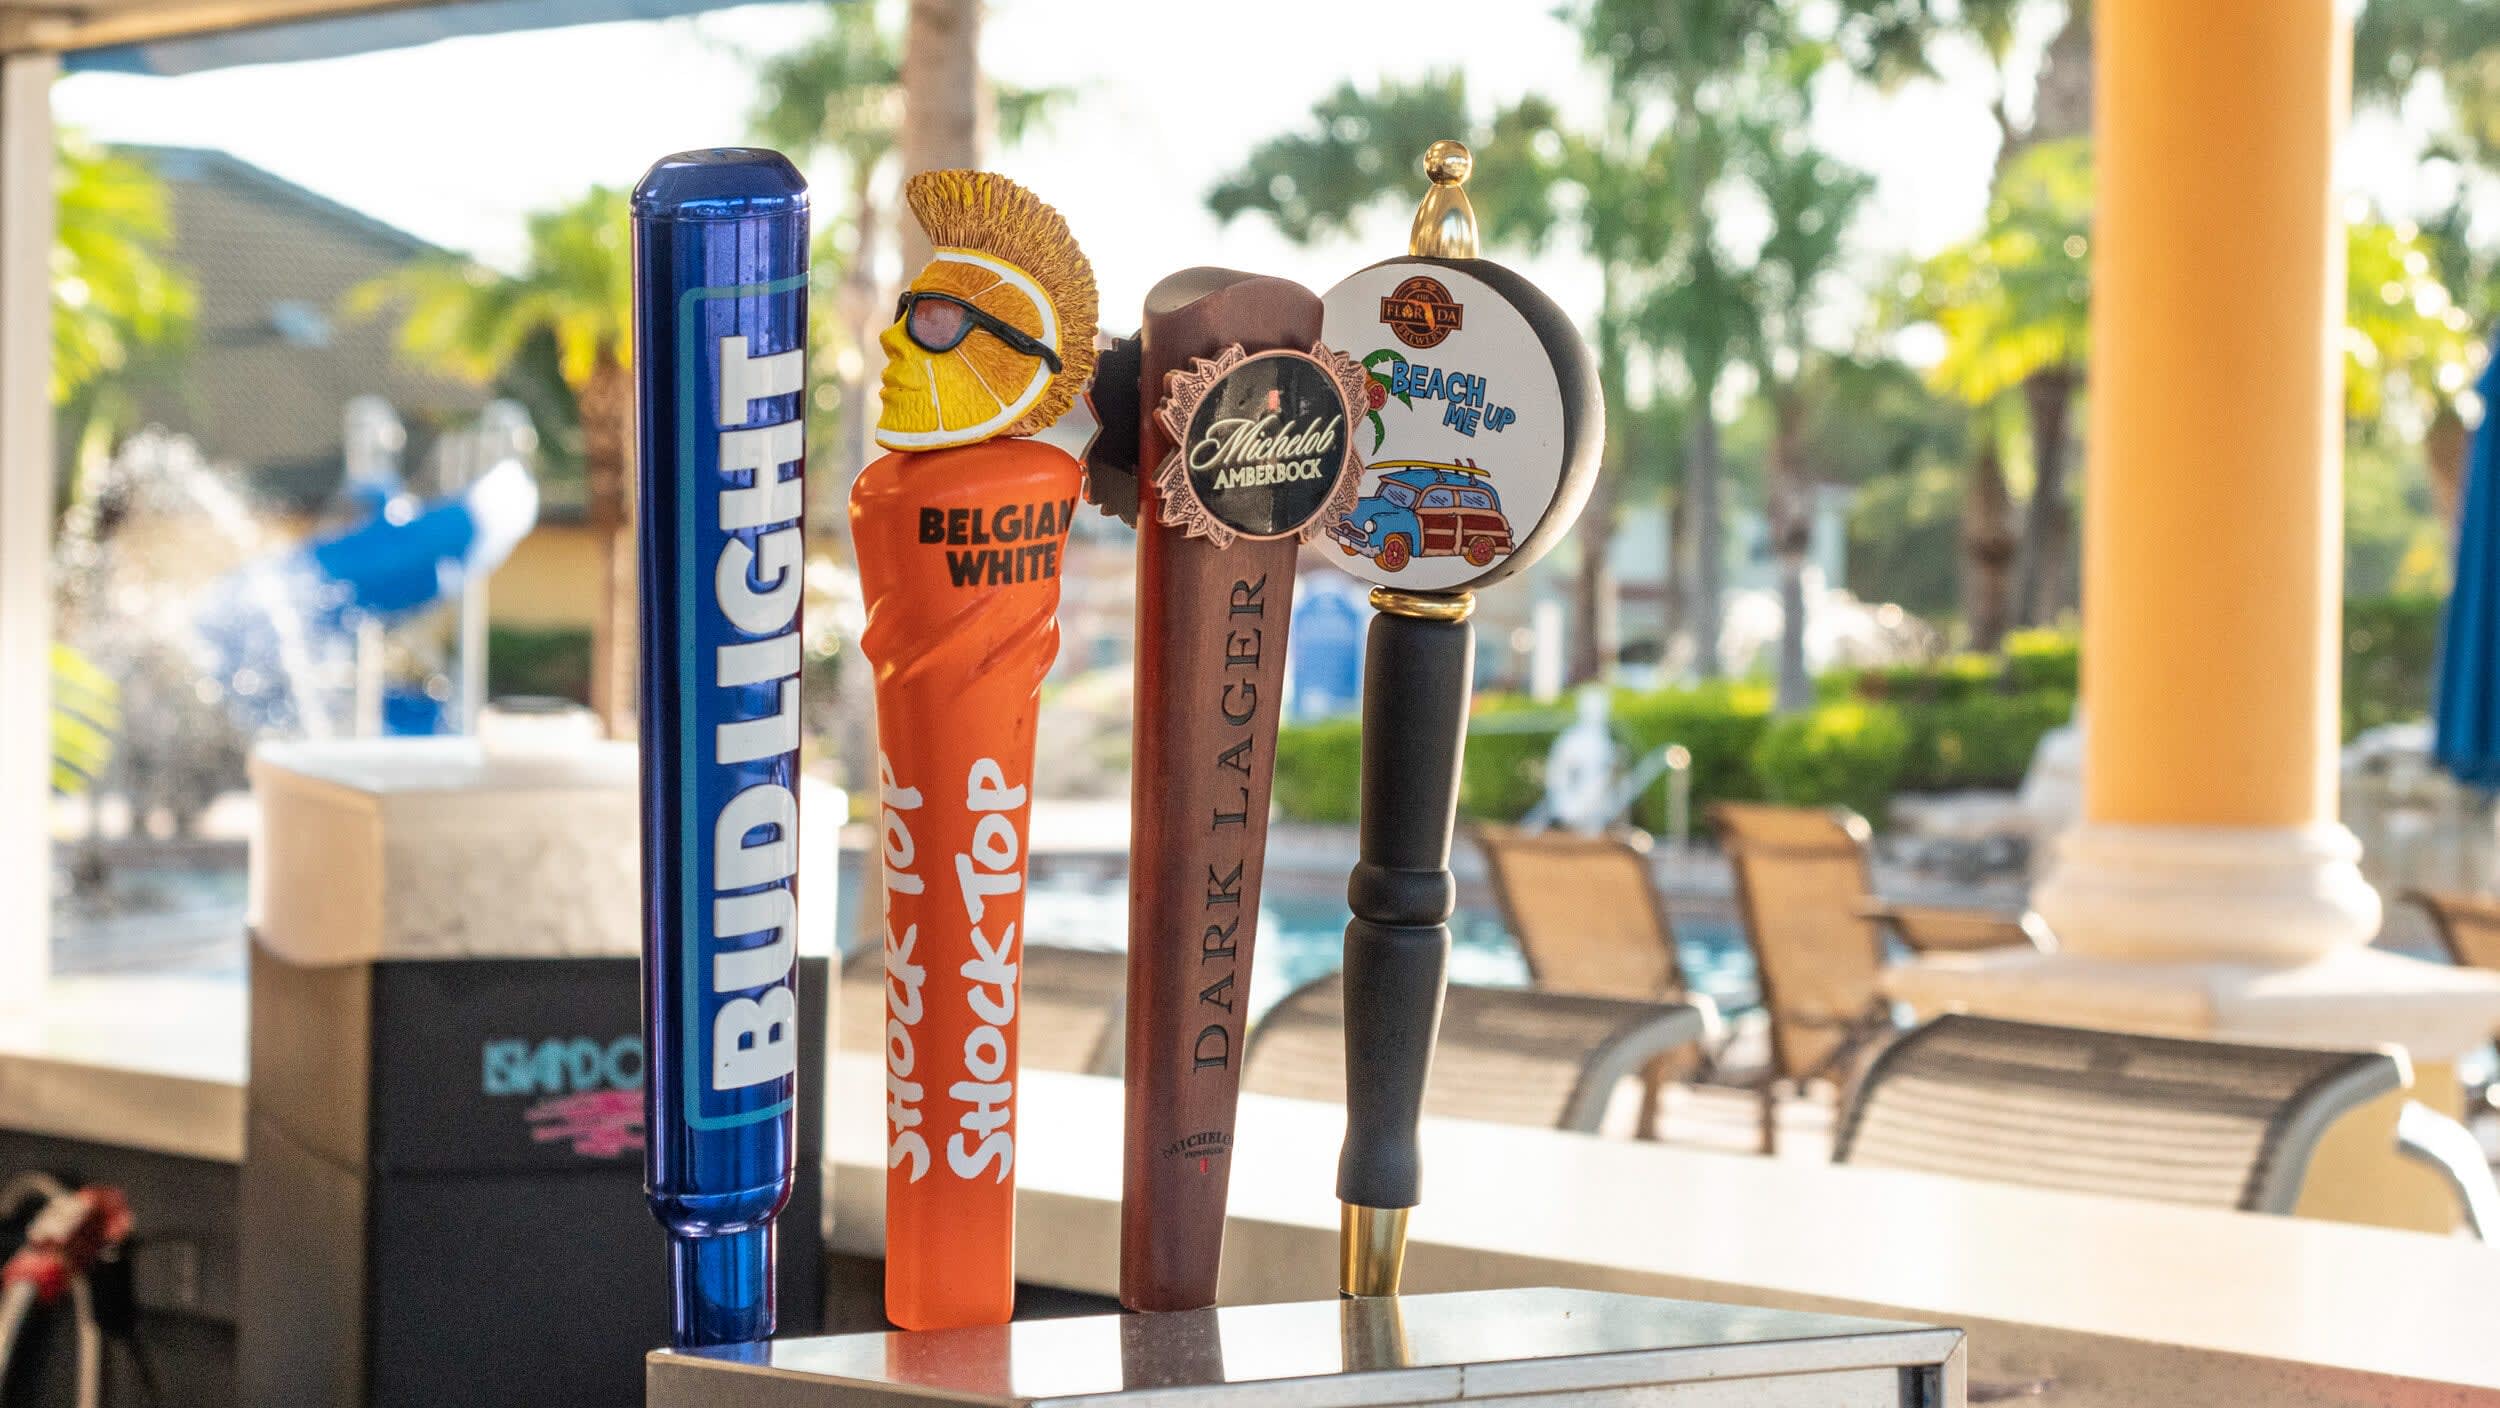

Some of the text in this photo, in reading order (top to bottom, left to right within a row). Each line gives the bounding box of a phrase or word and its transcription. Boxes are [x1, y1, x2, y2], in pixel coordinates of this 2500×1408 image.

[1391, 360, 1487, 408] BEACH
[1190, 415, 1342, 471] Michelob
[1443, 402, 1516, 438] ME UP
[1213, 458, 1323, 490] AMBERBOCK
[918, 497, 1076, 546] BELGIAN
[945, 542, 1057, 588] WHITE
[712, 335, 803, 1091] BUD LIGHT
[1193, 573, 1267, 1074] DARK LAGER
[947, 757, 1027, 1185] SHOCK TOP
[886, 921, 931, 1184] SHOCK
